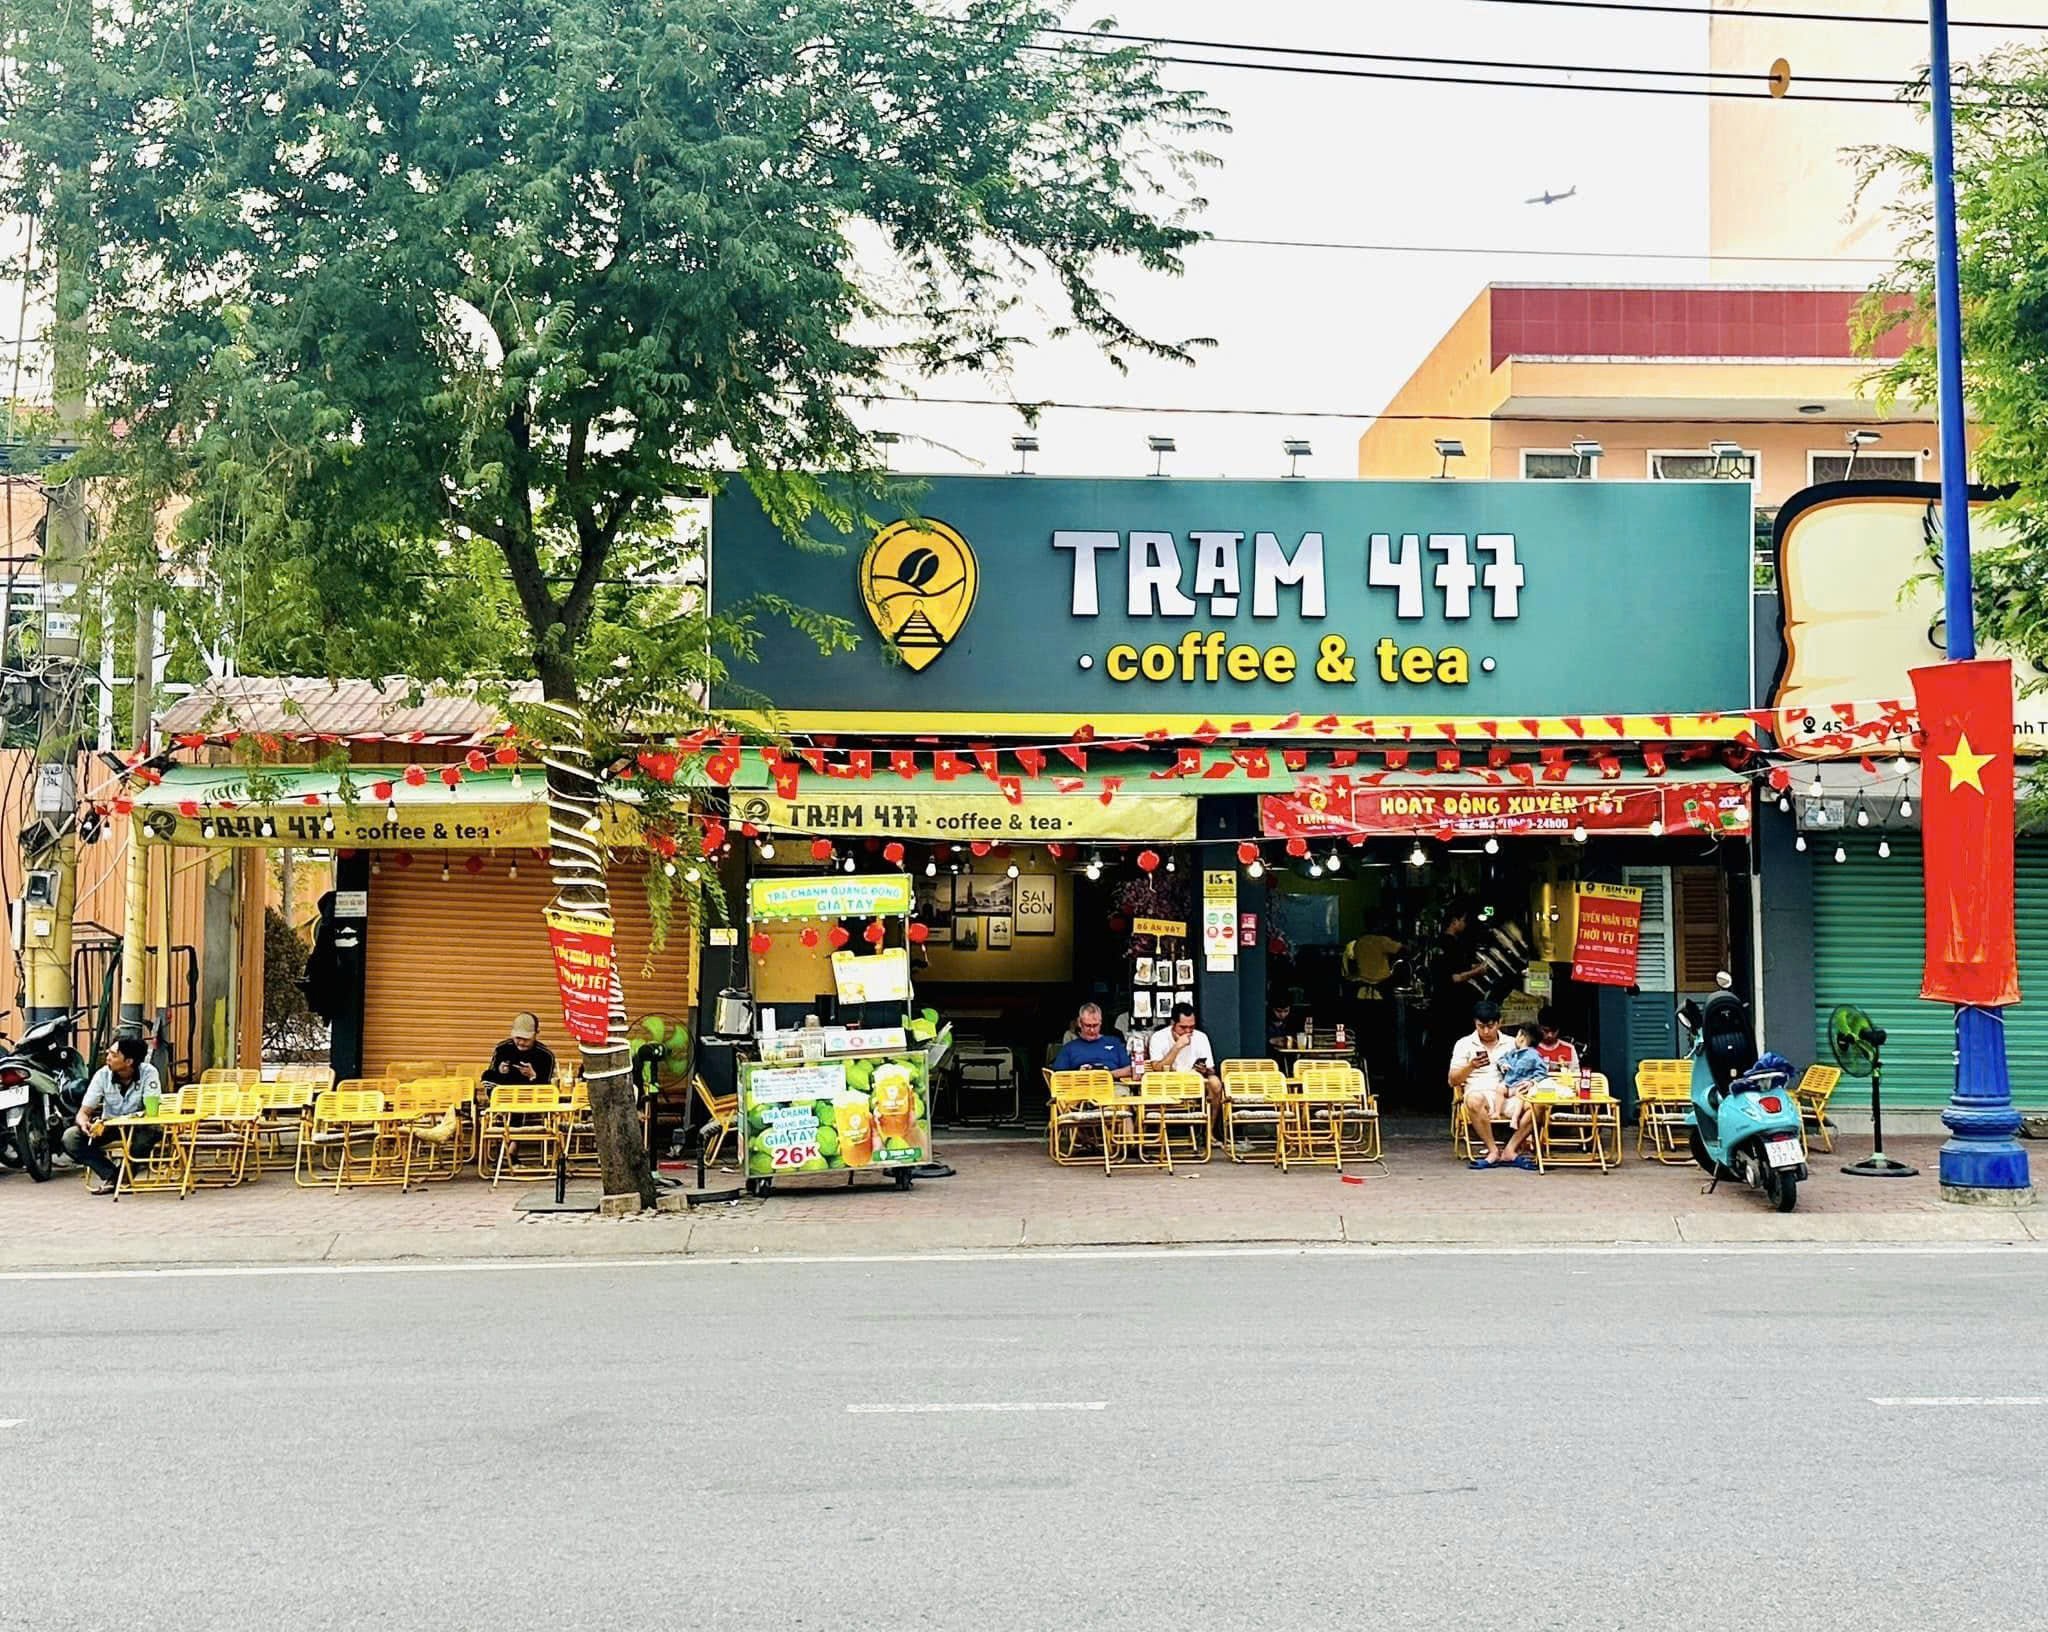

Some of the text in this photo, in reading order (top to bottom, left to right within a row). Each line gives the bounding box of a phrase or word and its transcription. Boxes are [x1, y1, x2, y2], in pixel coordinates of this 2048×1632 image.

[1053, 530, 1525, 619] TRẠM 477
[1105, 631, 1470, 684] coffee & tea
[1380, 796, 1436, 818] HOẠT
[1443, 792, 1501, 819] ĐỘNG
[1508, 792, 1578, 815] XUYÊN
[874, 804, 918, 829] 477
[936, 813, 1002, 831] coffee
[1008, 813, 1023, 831] &
[1029, 814, 1062, 831] tea
[356, 822, 426, 840] coffee
[433, 823, 449, 840] &
[455, 824, 489, 840] tea
[1021, 890, 1047, 903] SAI
[1018, 902, 1053, 915] GON
[775, 1146, 817, 1166] 26K
